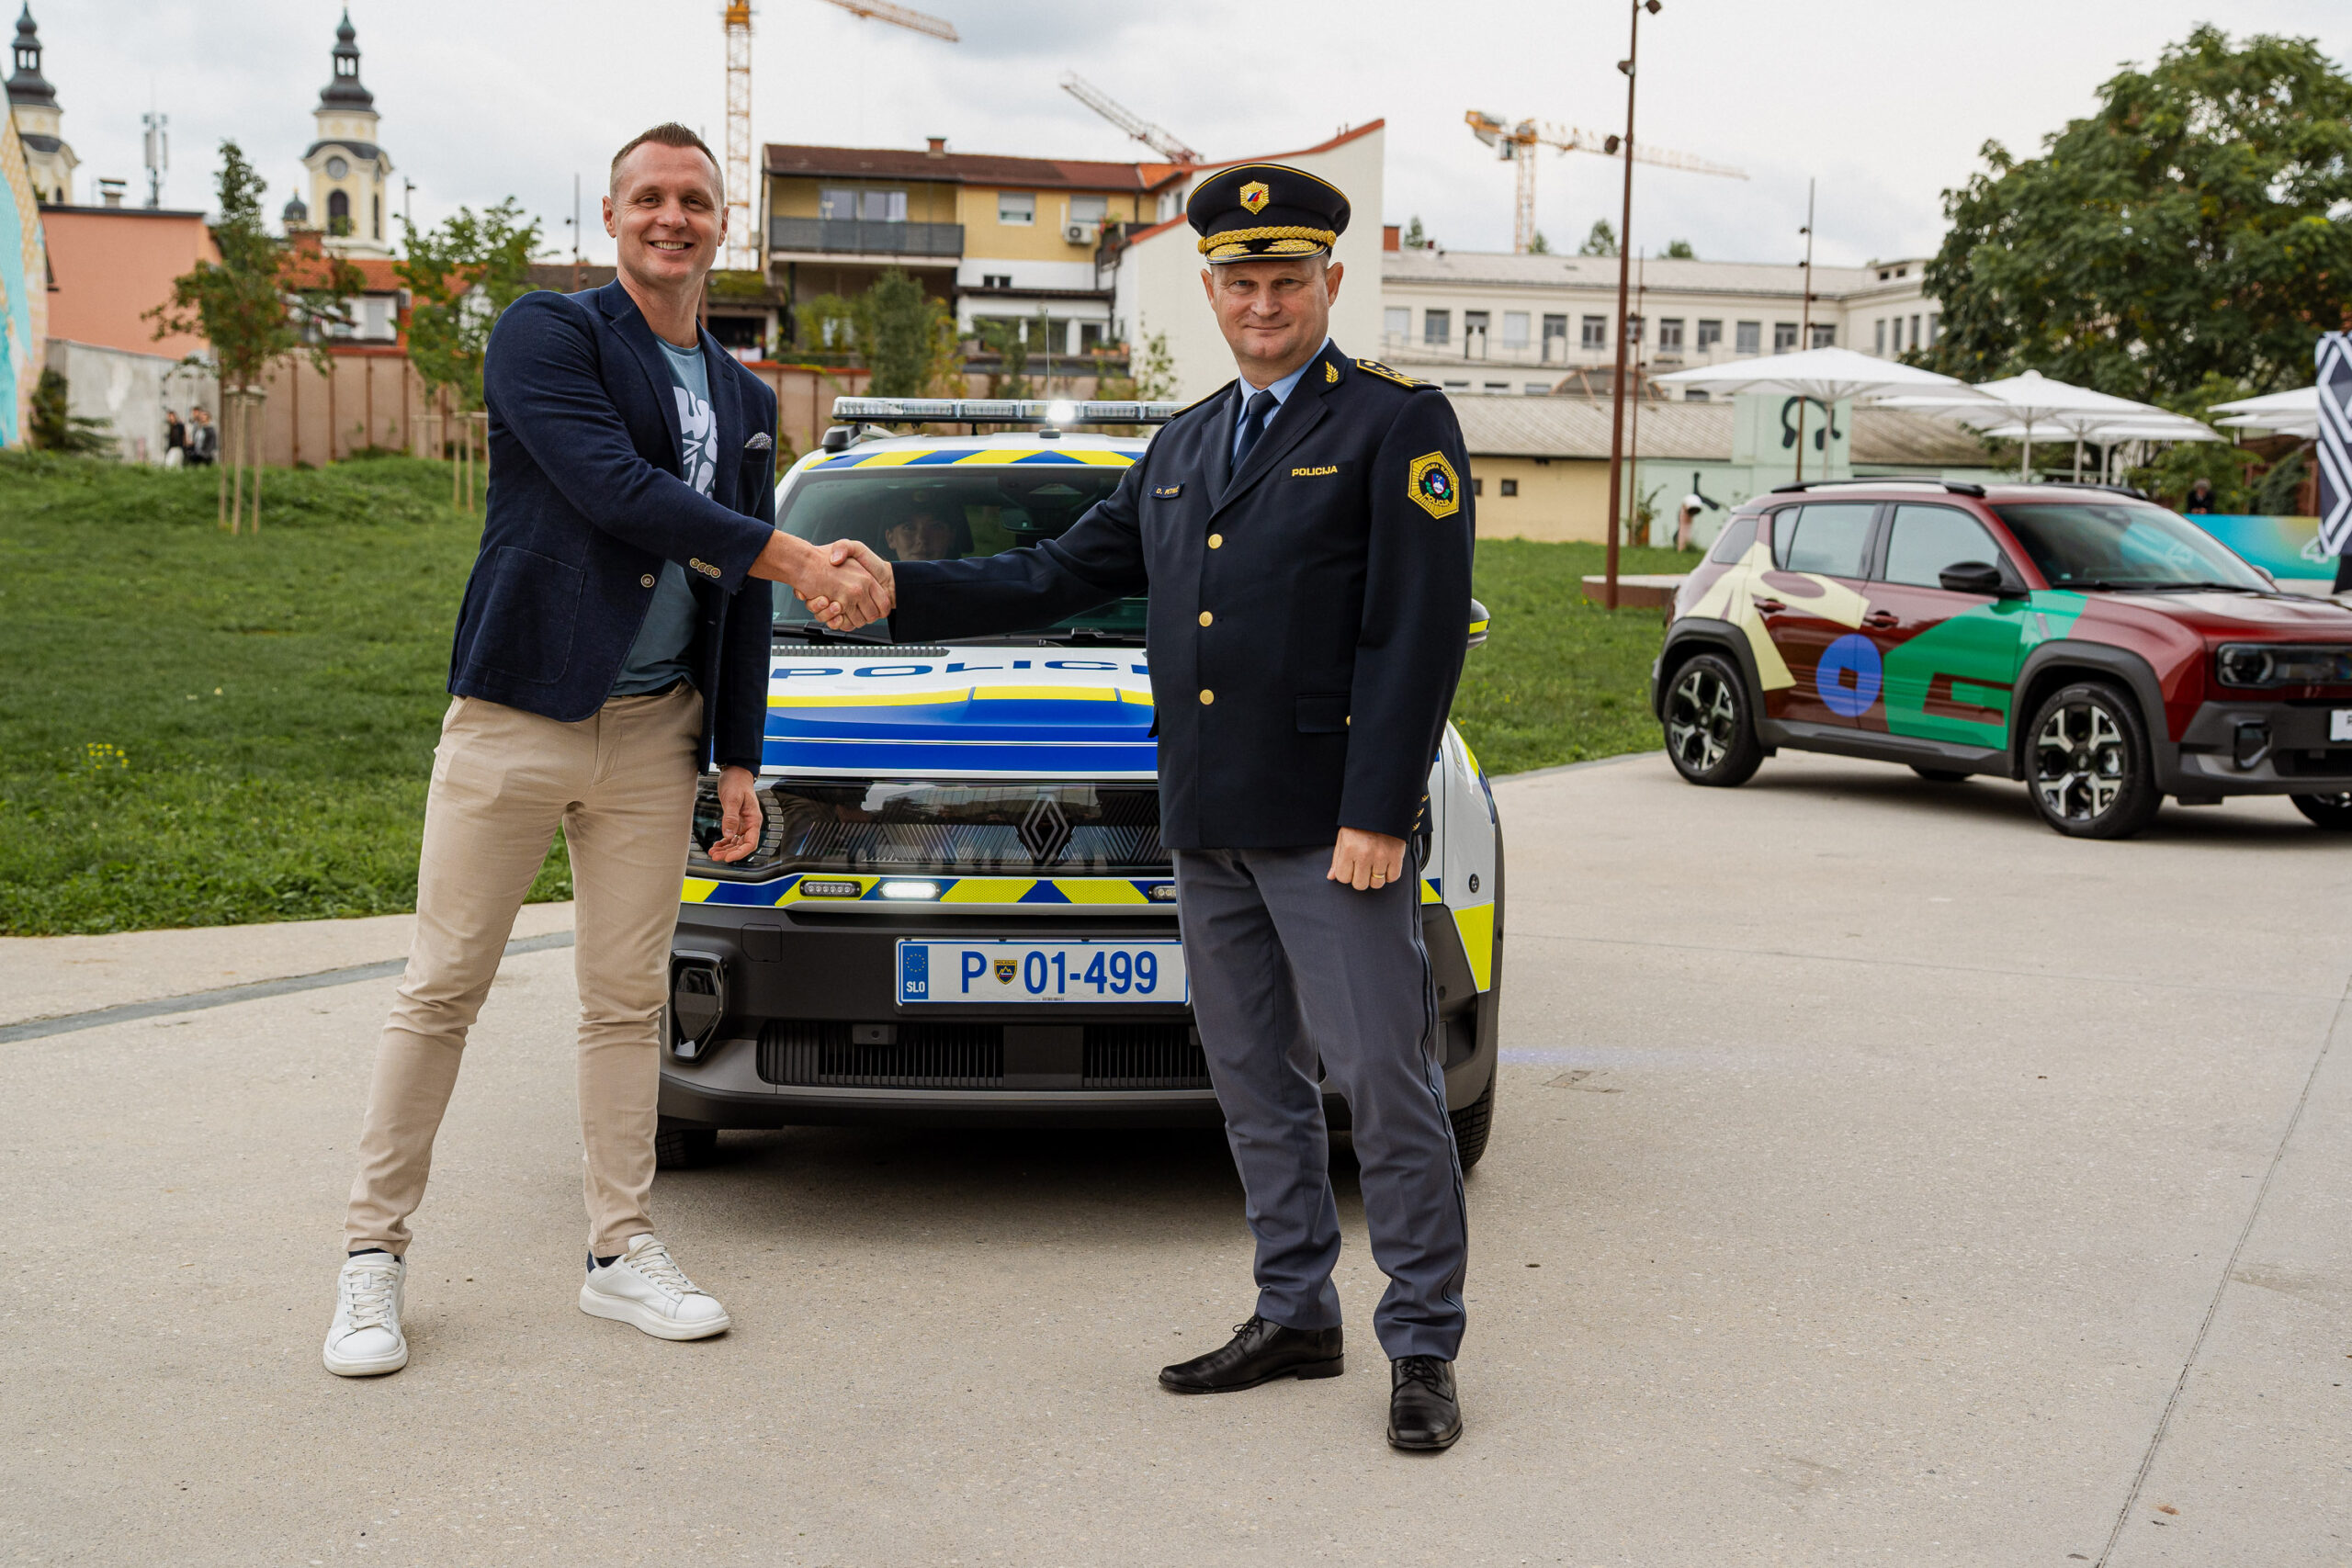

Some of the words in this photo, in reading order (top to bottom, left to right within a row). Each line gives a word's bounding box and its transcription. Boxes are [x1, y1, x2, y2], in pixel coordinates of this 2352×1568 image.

[1291, 465, 1338, 477] POLICIJA
[961, 951, 987, 994] P
[1023, 950, 1158, 994] 01-499
[906, 981, 925, 993] SLO
